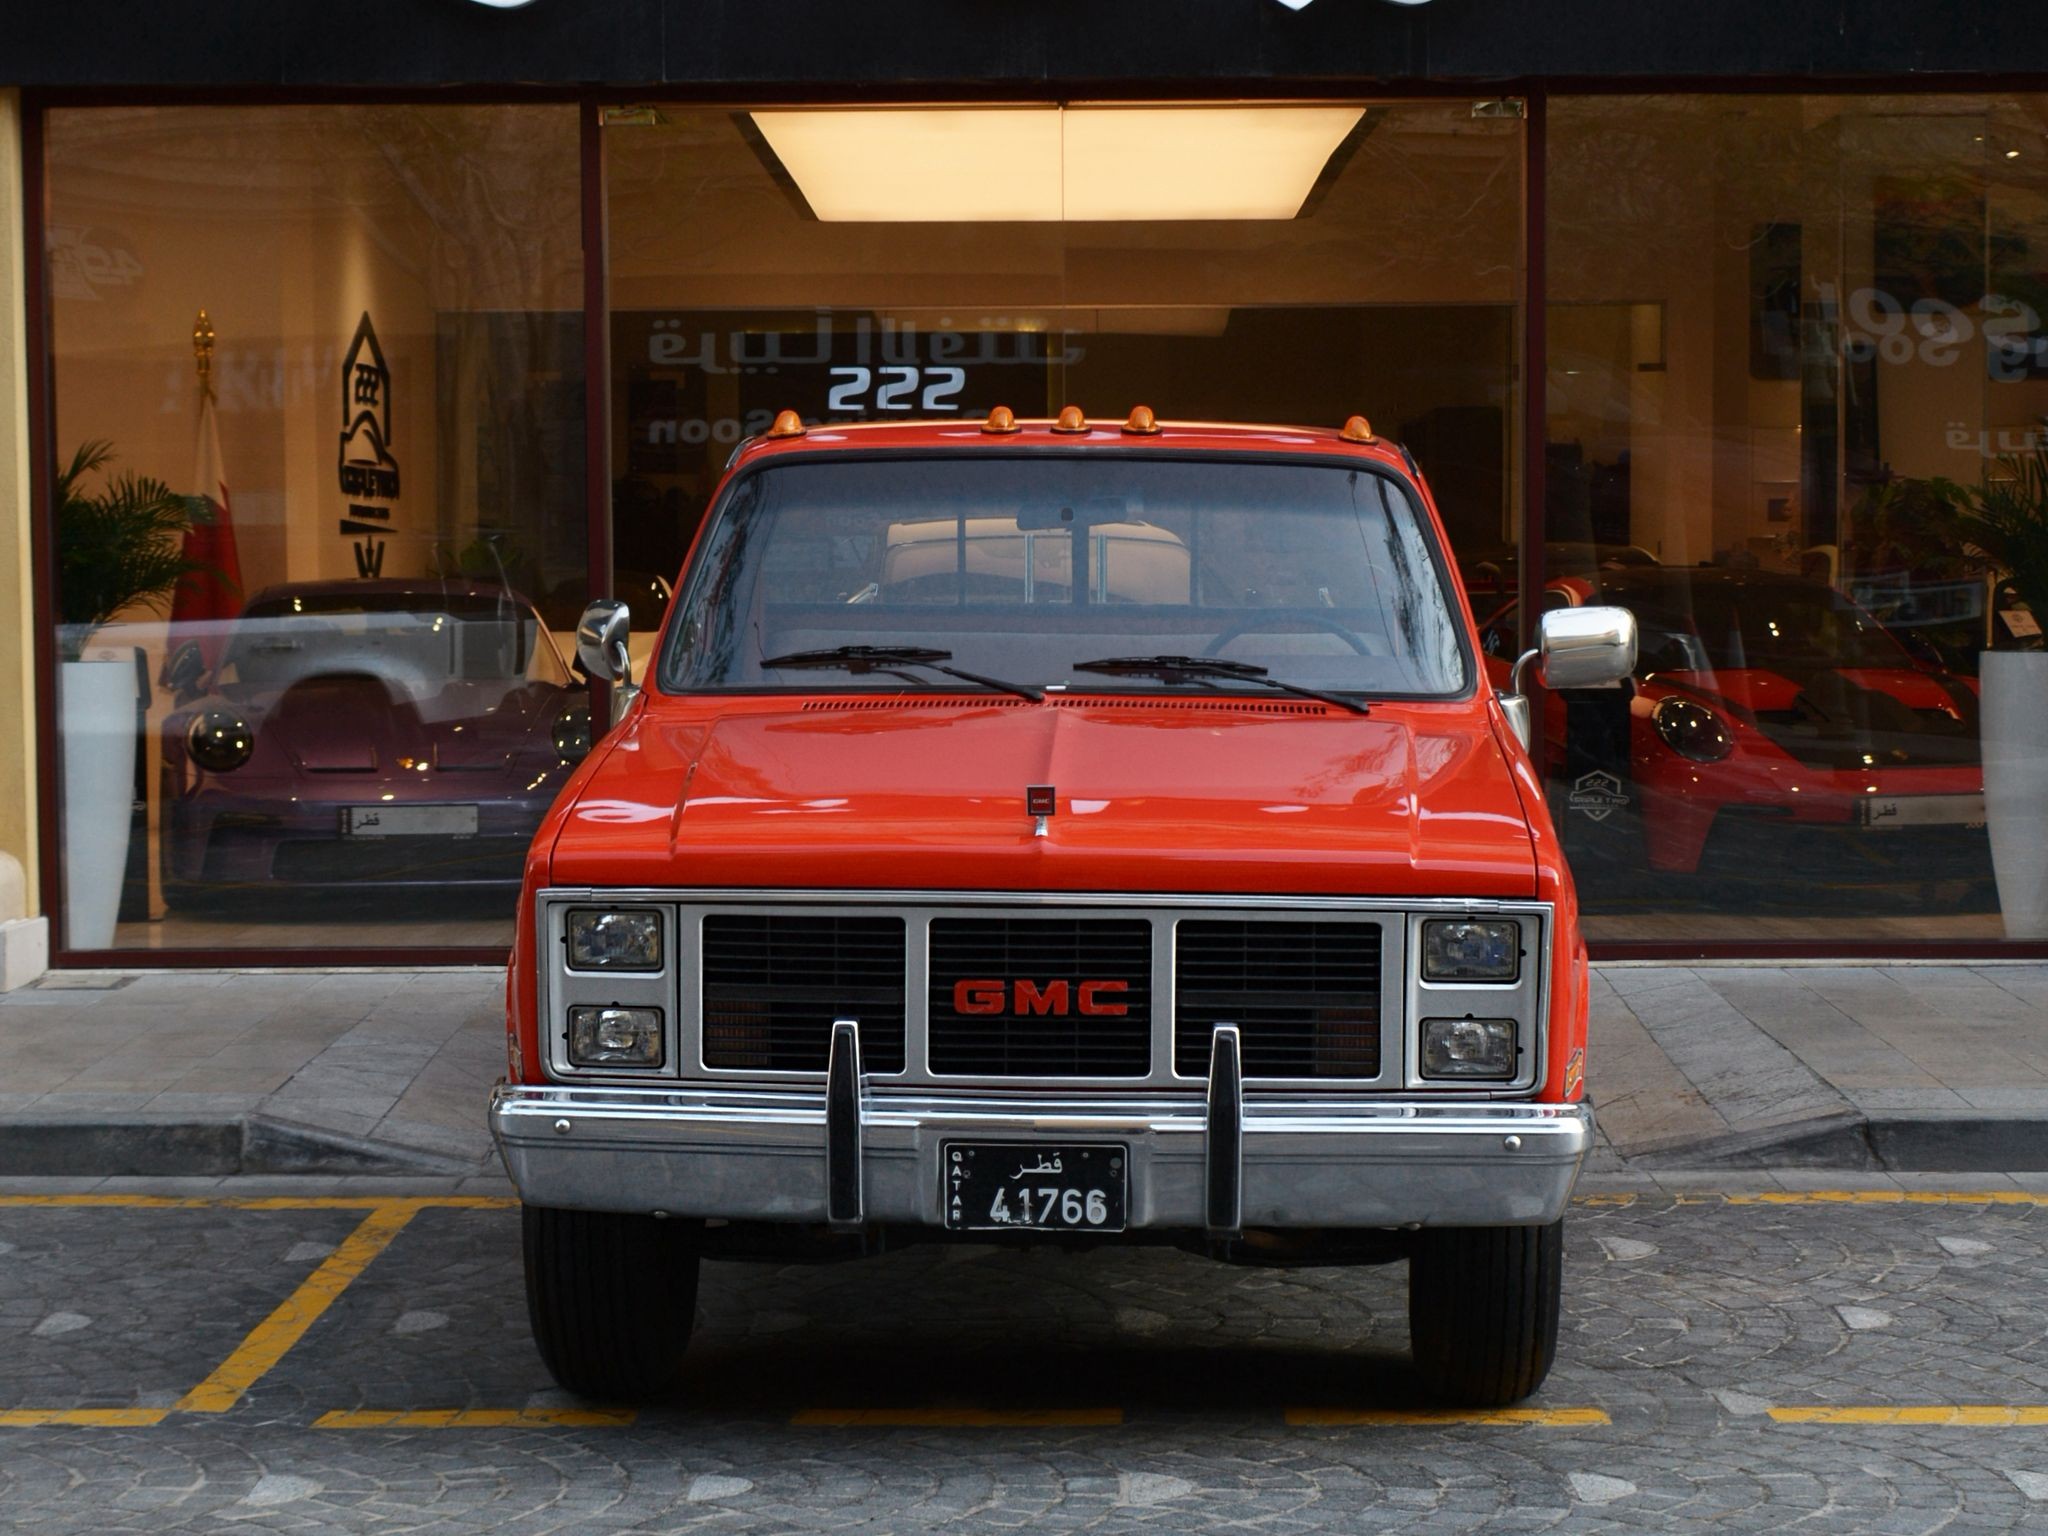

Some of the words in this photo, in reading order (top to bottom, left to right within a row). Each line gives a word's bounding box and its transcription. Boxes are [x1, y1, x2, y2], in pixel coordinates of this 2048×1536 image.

[829, 366, 966, 410] 222
[355, 812, 381, 829] قطر
[953, 979, 1129, 1016] GMC
[1009, 1152, 1064, 1179] قطر
[951, 1151, 963, 1221] QATAR
[989, 1187, 1108, 1225] 41766
